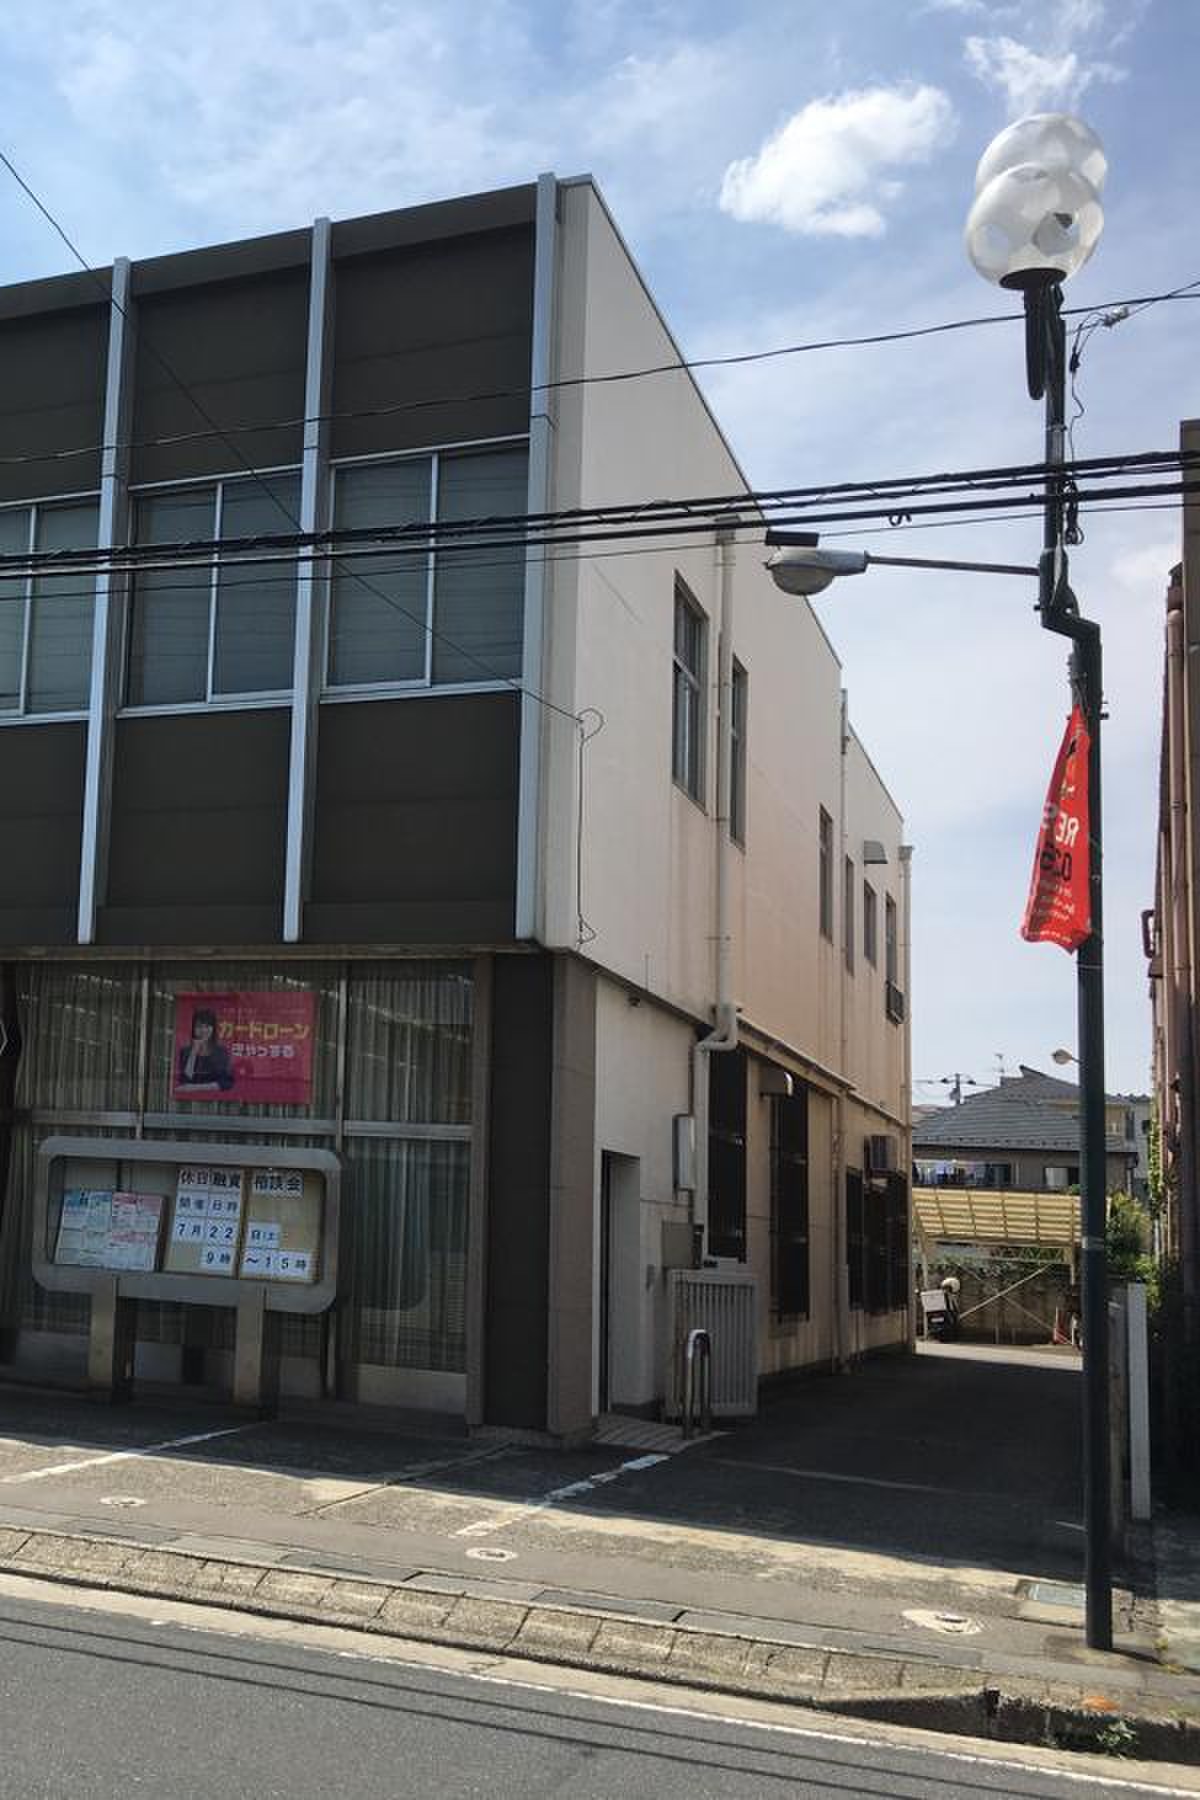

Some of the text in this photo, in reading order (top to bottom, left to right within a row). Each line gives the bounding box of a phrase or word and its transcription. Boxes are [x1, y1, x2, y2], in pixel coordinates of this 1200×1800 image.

[218, 1020, 311, 1039] カードローン
